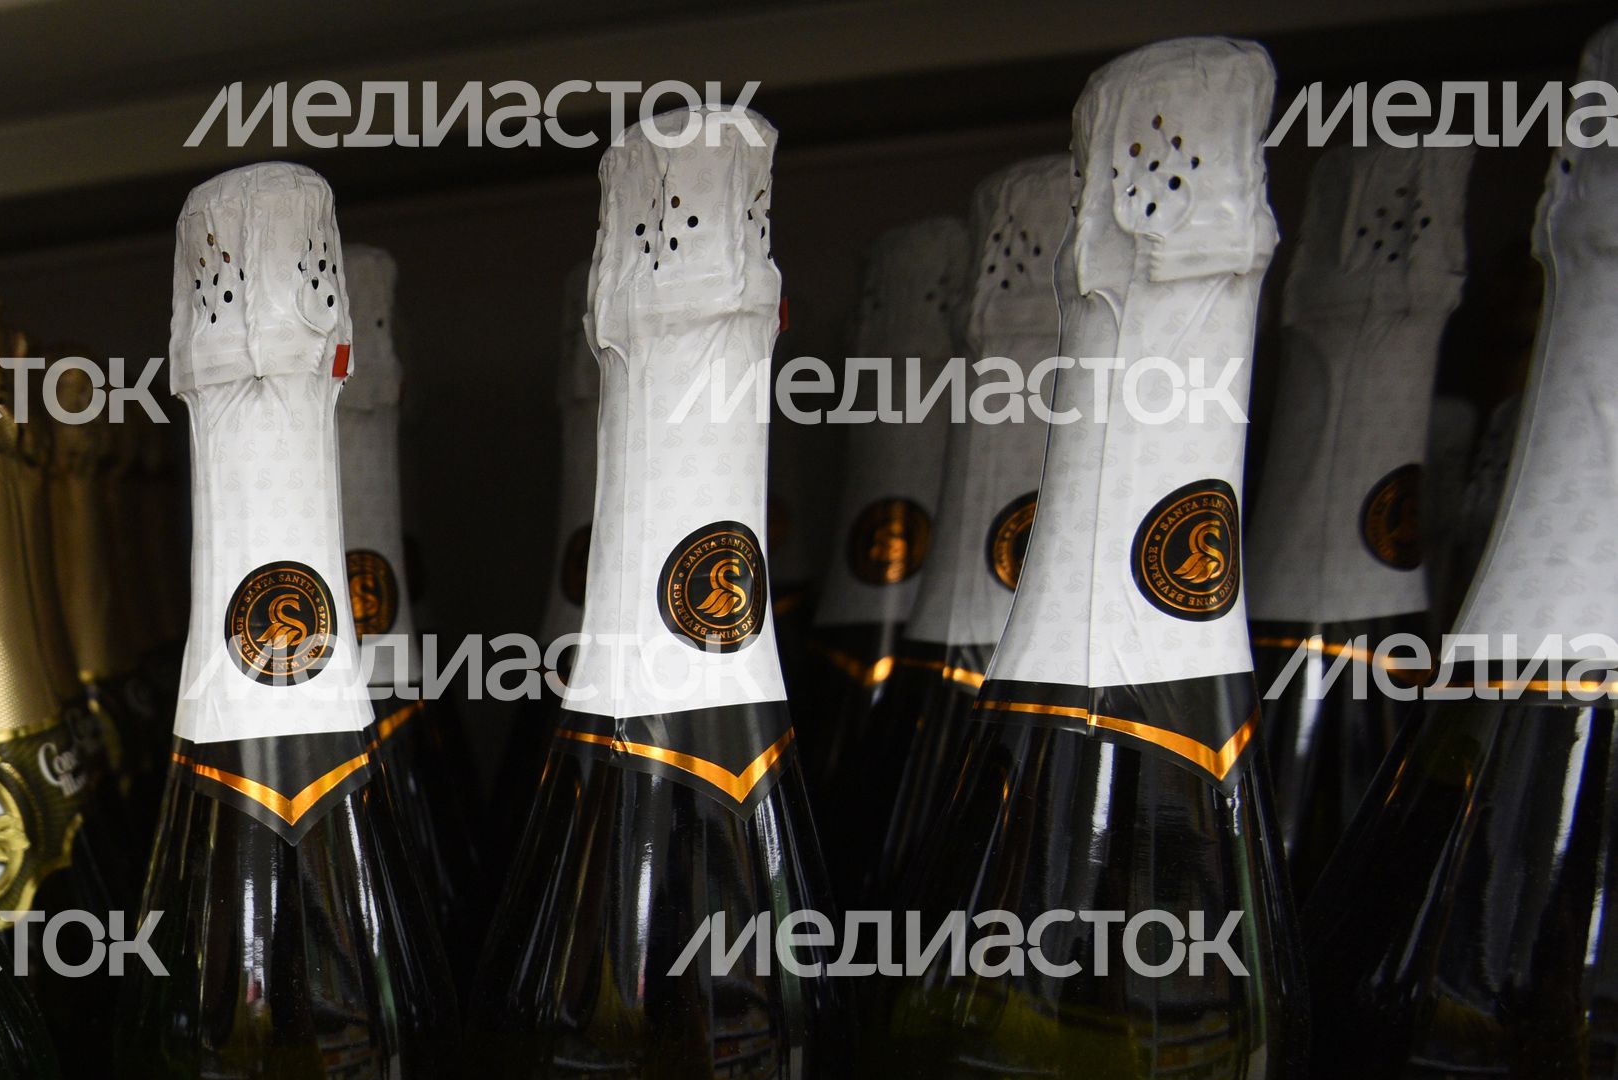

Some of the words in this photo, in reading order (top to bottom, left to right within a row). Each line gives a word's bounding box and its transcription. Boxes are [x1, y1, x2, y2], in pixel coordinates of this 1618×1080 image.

[683, 541, 717, 568] SANTA
[245, 577, 276, 603] SANTA
[278, 574, 316, 595] SANYTA
